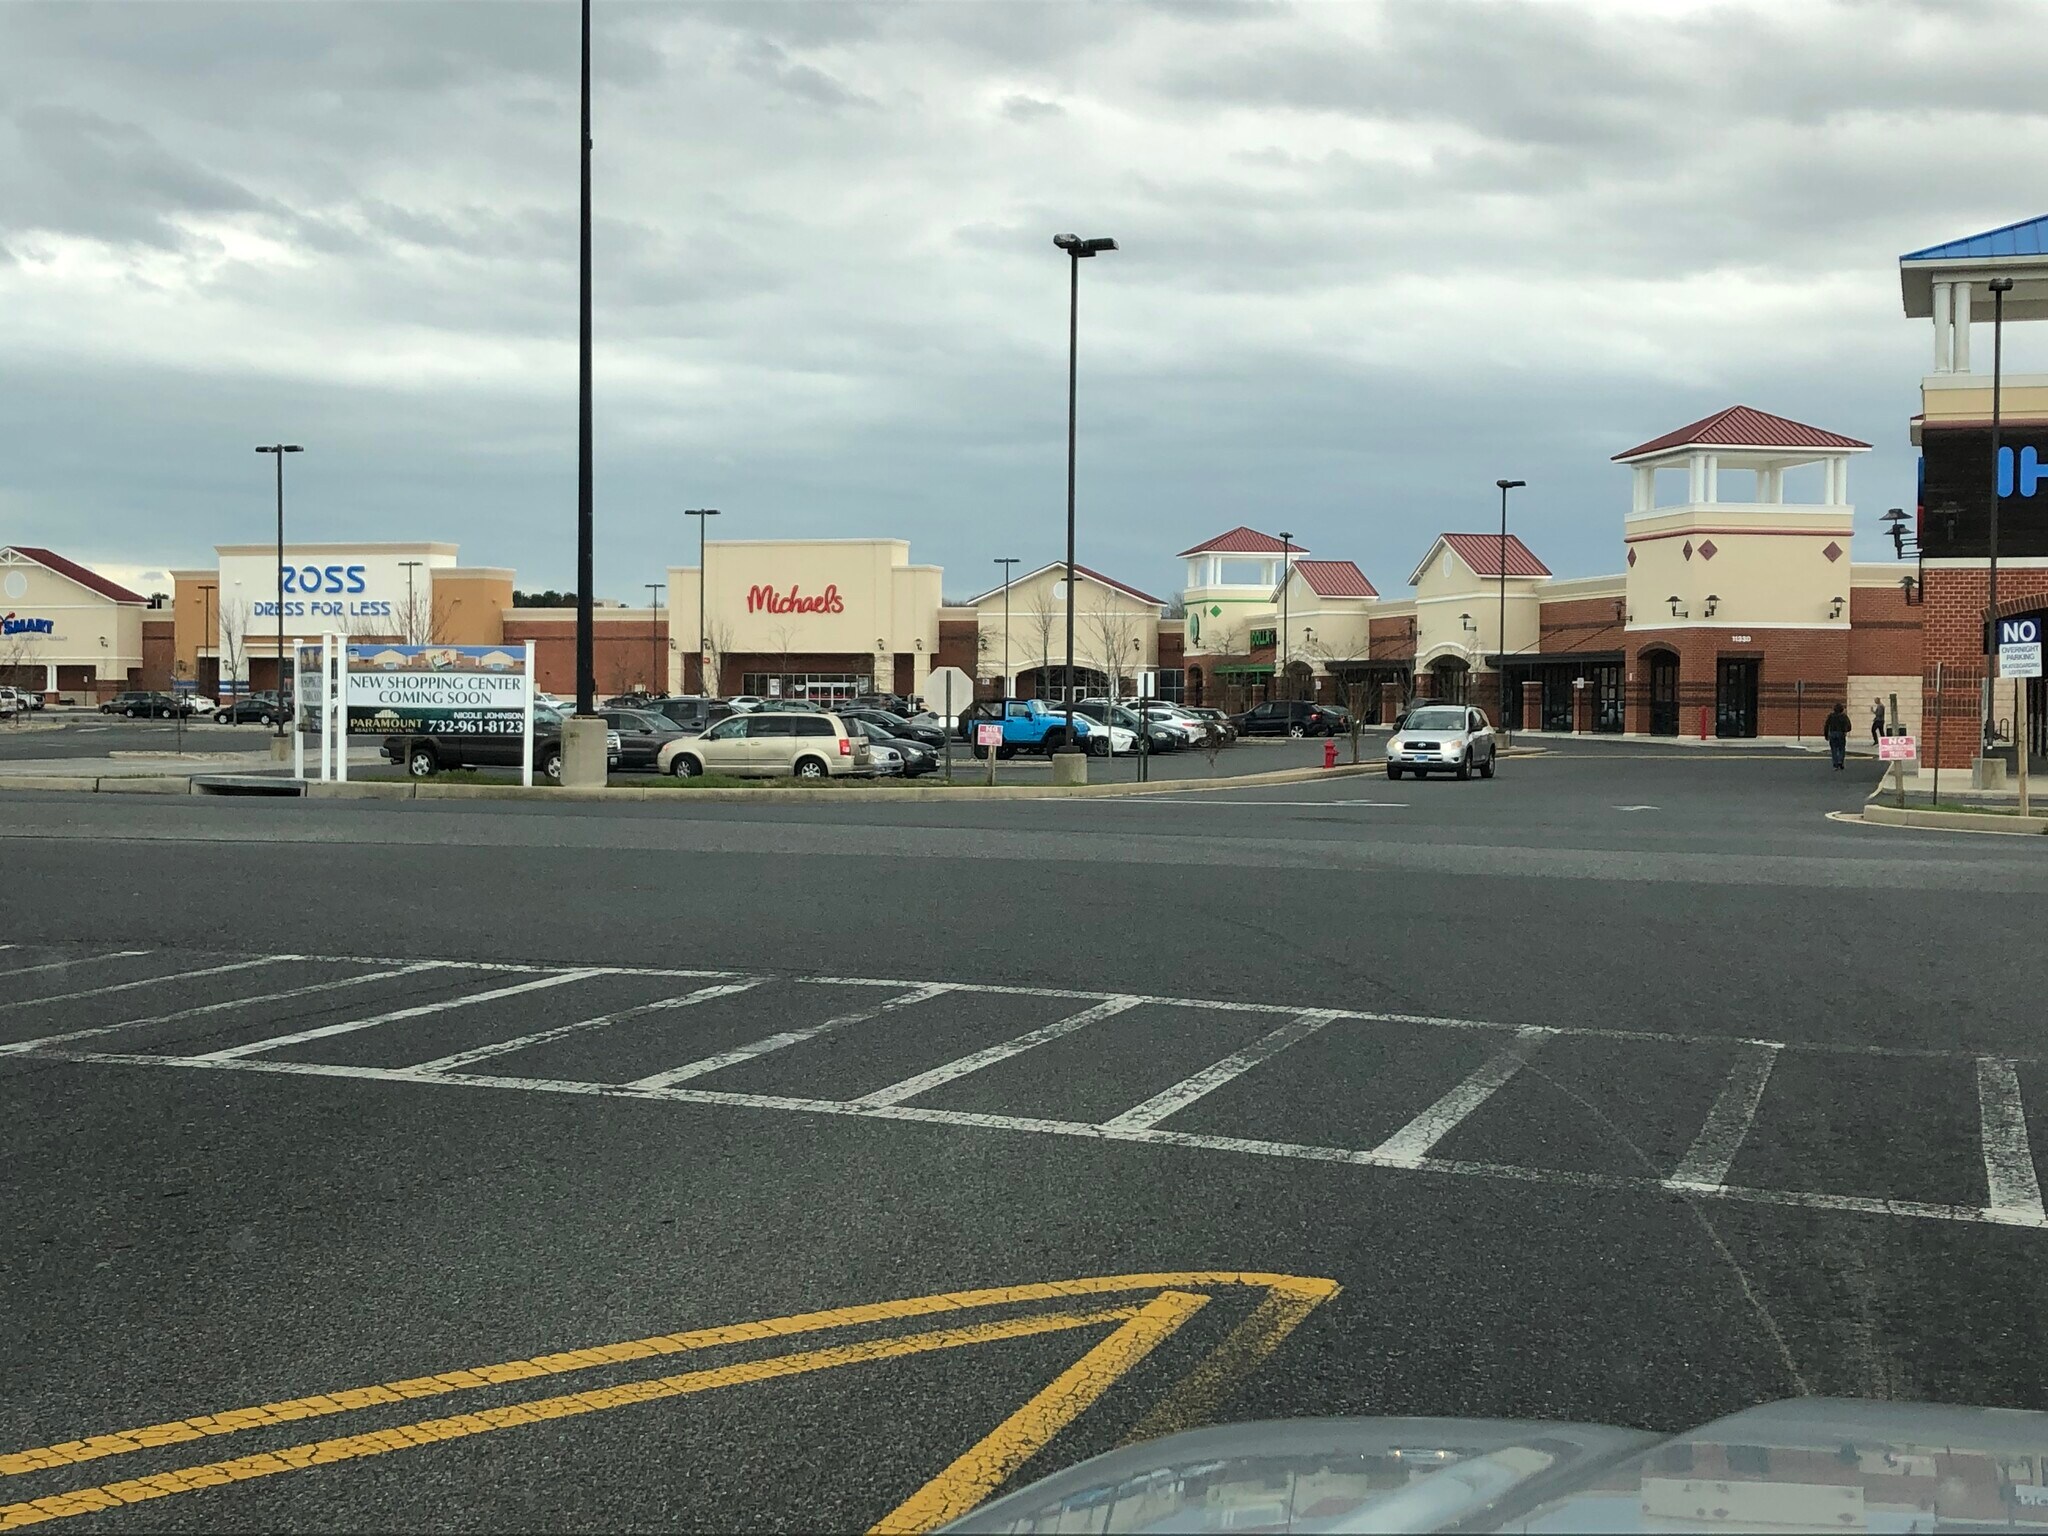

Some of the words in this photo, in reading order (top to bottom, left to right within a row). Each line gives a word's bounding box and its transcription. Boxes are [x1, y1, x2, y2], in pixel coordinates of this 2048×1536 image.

[746, 584, 844, 614] Michaels
[311, 601, 344, 616] FOR
[350, 601, 391, 616] LESS
[2003, 620, 2036, 643] NO
[2001, 645, 2039, 654] OVERNIGHT
[2006, 653, 2035, 661] PARKING
[350, 675, 384, 689] NEW
[387, 675, 464, 690] SHOPPING
[467, 677, 521, 691] CENTER
[379, 690, 443, 704] COMING
[447, 691, 492, 705] SOON
[453, 711, 483, 720] NICOLE
[484, 711, 524, 720] JOHNSON
[350, 718, 423, 728] PARAMOUNT
[428, 719, 524, 733] 732-961-8123
[1888, 737, 1907, 745] NO
